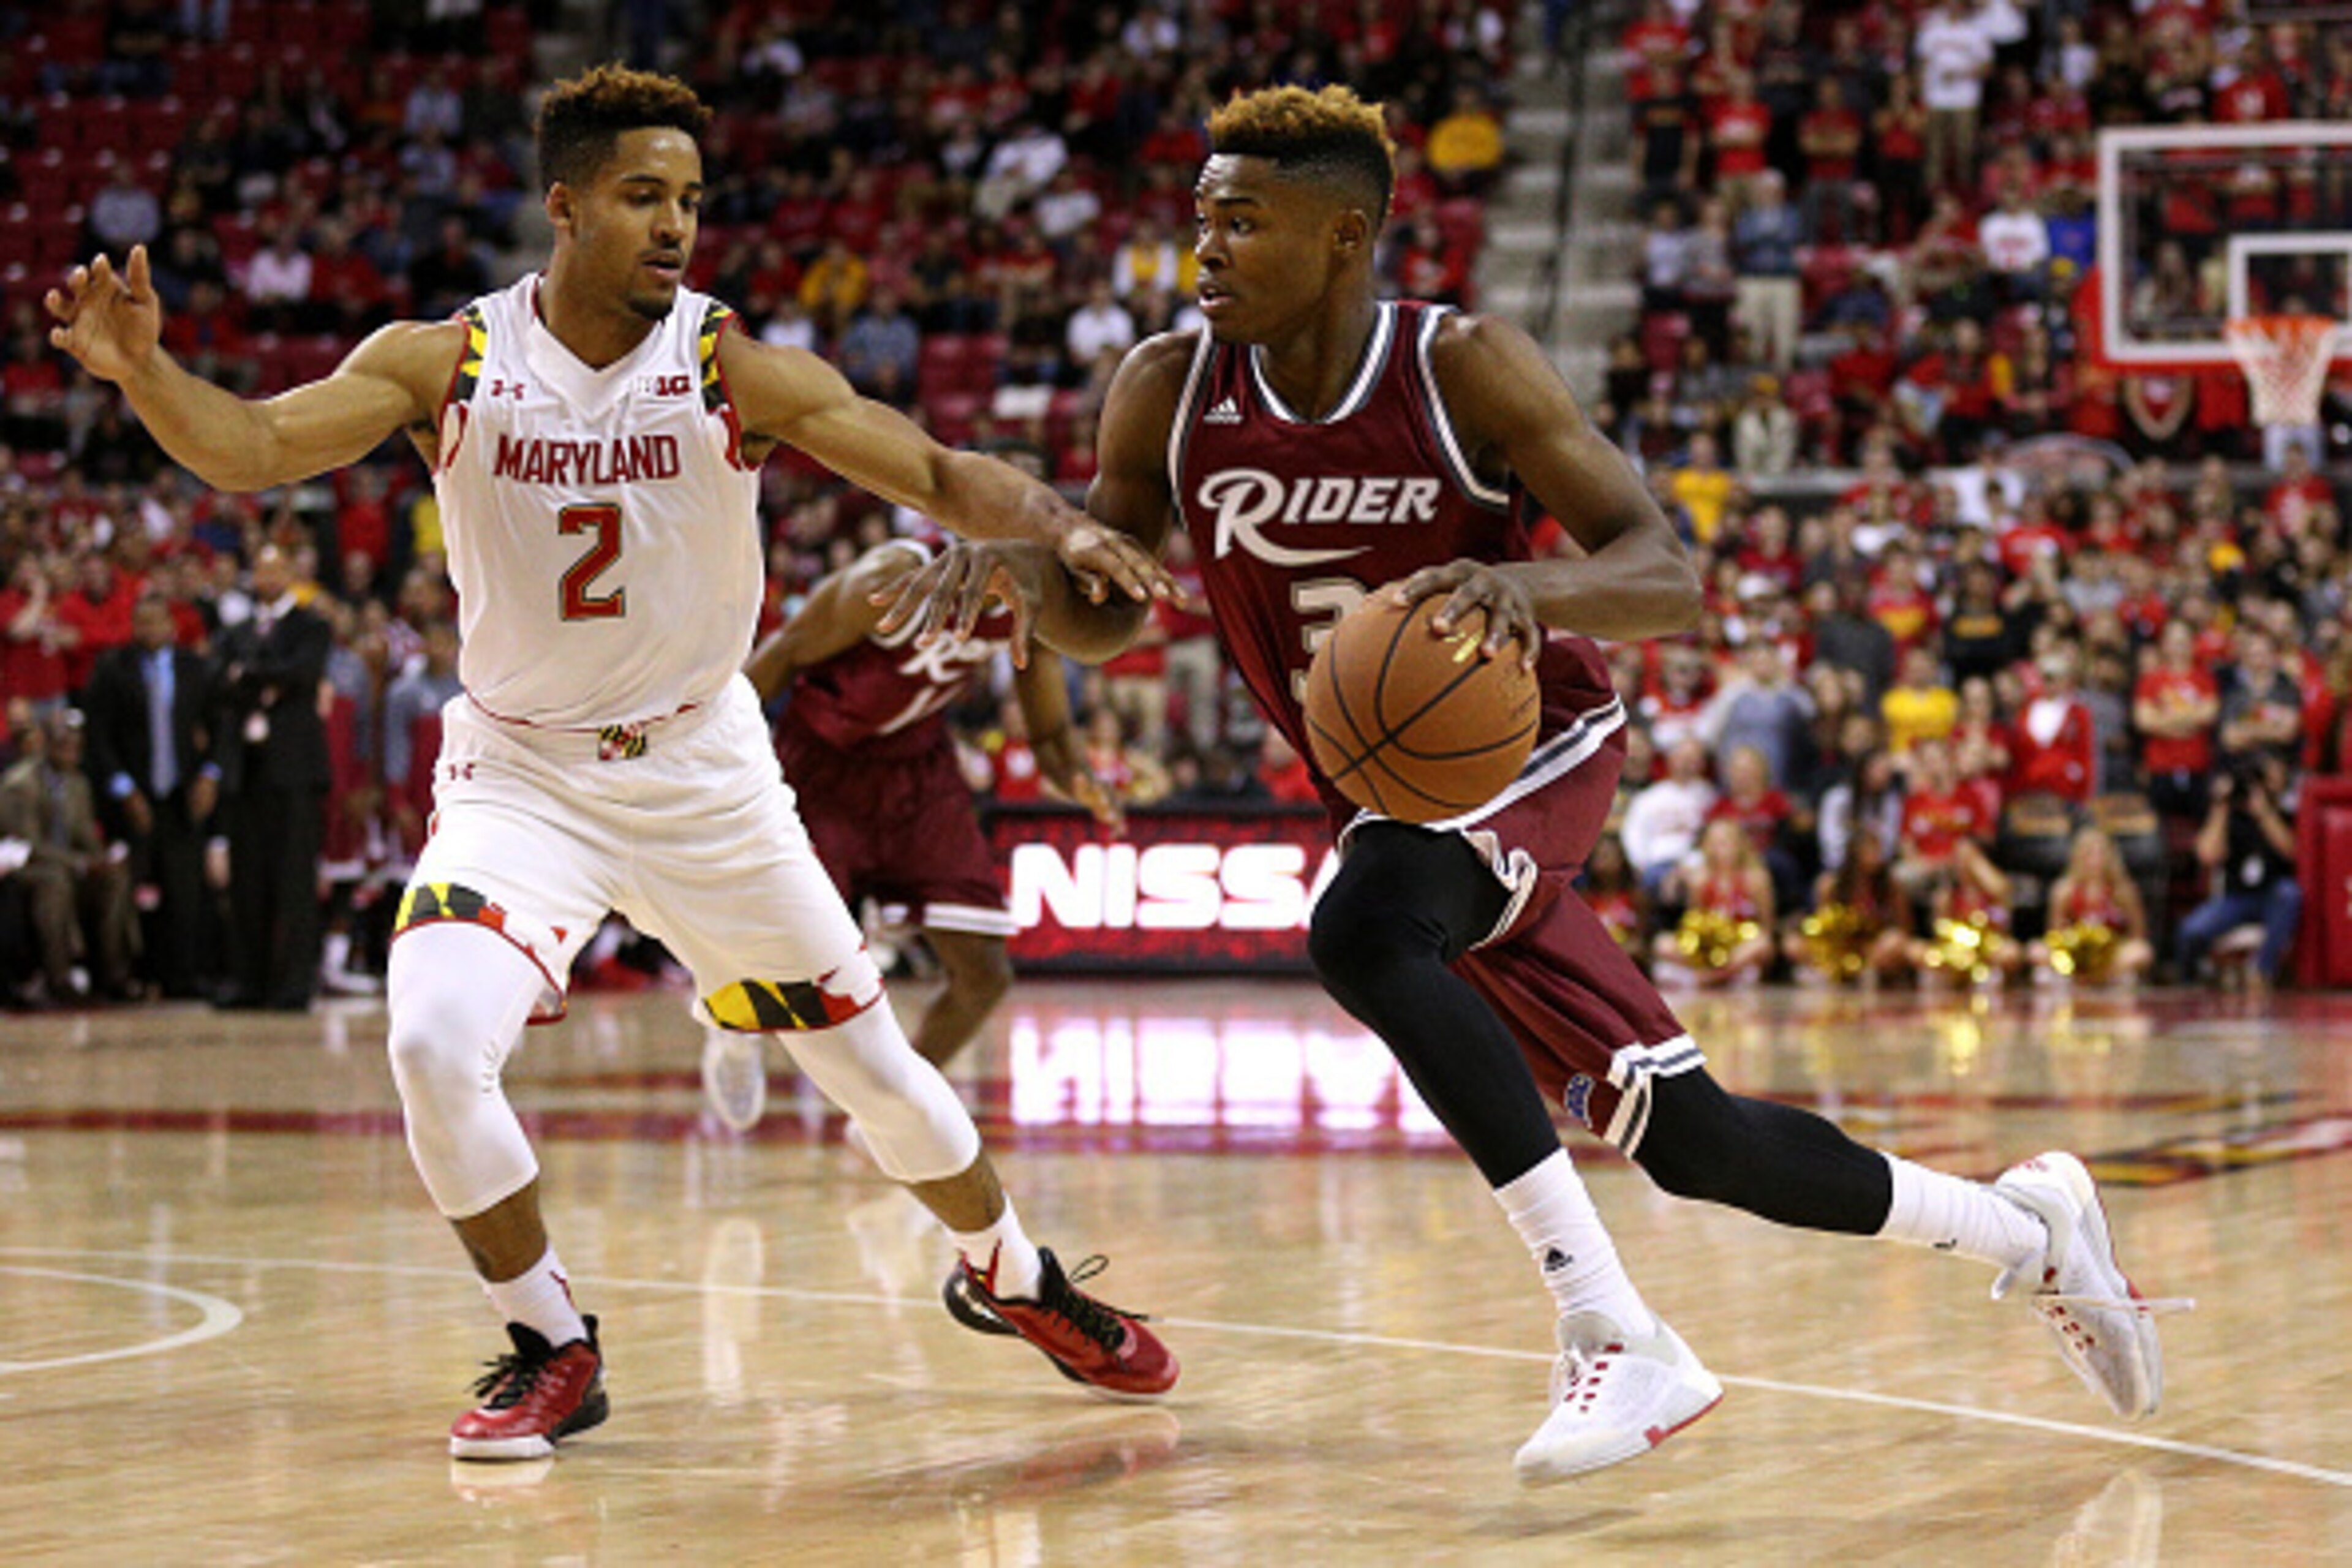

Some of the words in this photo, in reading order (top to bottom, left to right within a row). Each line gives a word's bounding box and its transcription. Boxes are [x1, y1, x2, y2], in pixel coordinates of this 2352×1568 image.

[493, 432, 681, 485] MARYLAND
[557, 503, 625, 621] 2
[1012, 842, 1340, 929] NISS
